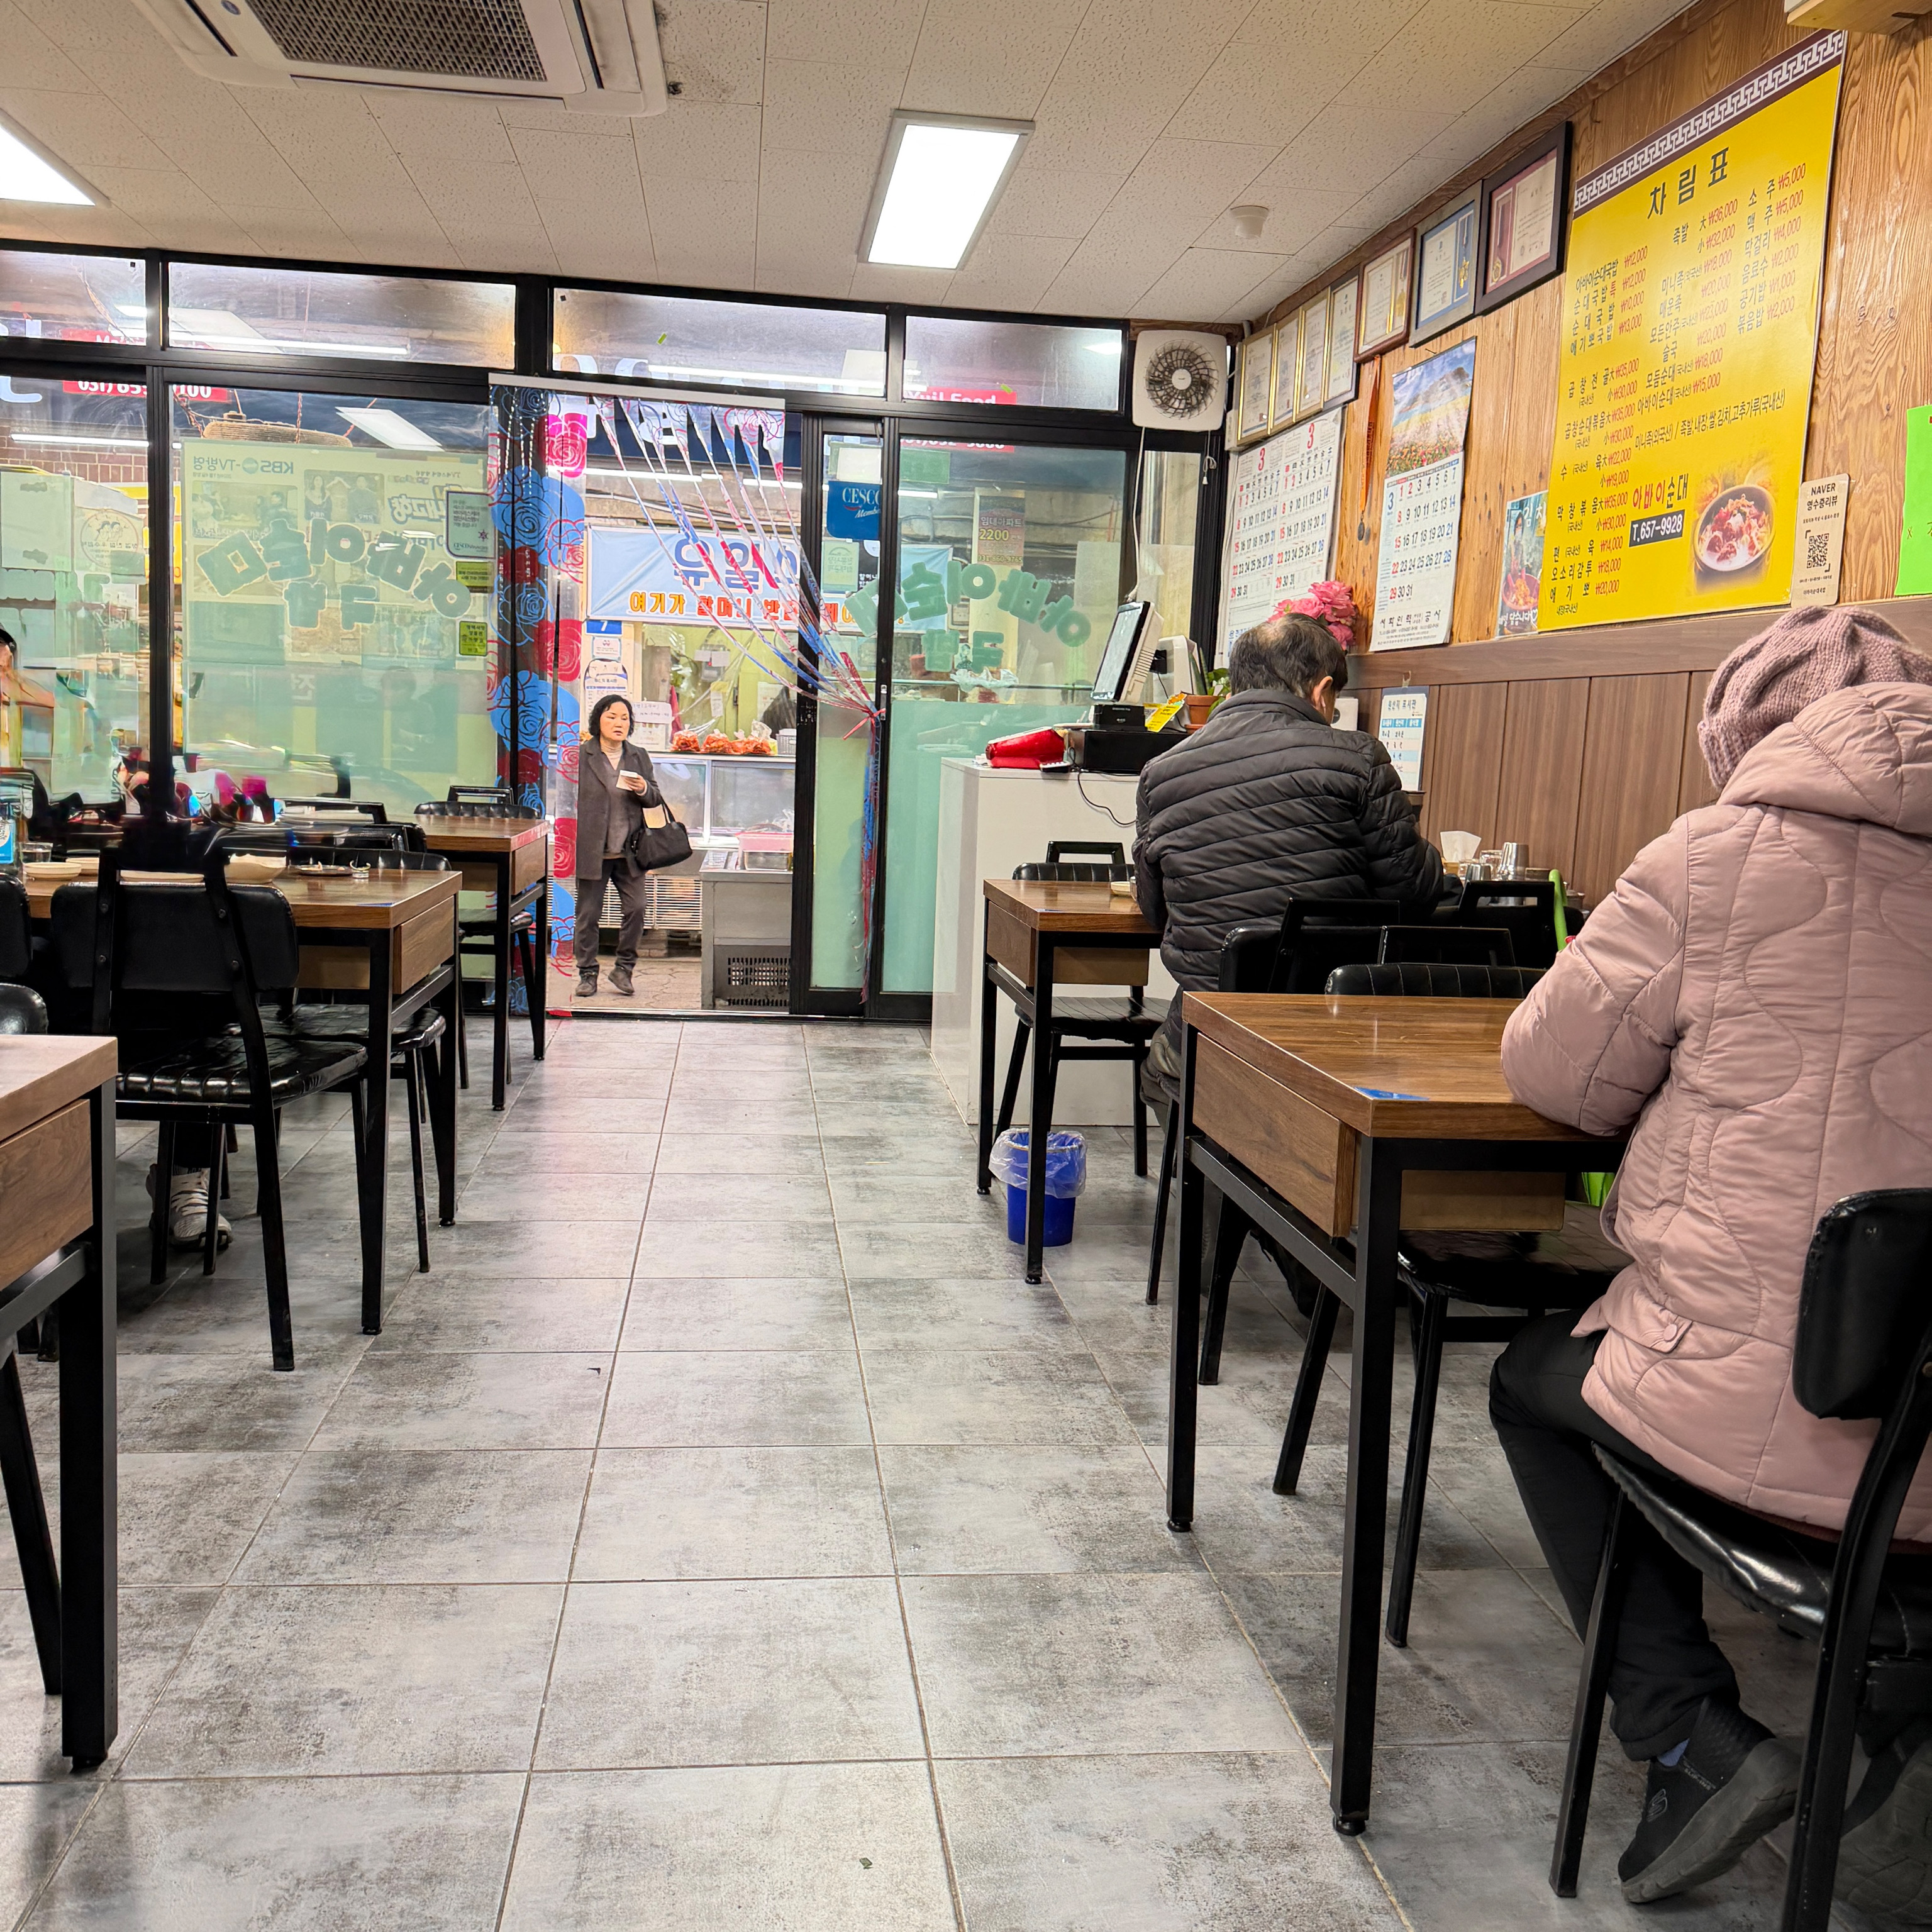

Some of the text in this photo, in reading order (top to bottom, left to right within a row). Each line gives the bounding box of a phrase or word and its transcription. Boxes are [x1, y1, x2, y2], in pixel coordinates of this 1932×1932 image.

[1647, 147, 1729, 219] 차림표
[1673, 222, 1689, 245] 족발
[1745, 229, 1771, 258] 막걸리
[1575, 258, 1619, 293] 아바이순대국밥
[1742, 256, 1768, 285] 음료수
[1740, 280, 1766, 309] 공기밥
[1307, 423, 1315, 449] 3
[1258, 447, 1265, 472] 3
[1400, 467, 1456, 497] 1 2 3 4 5 6 7
[1633, 473, 1689, 509] 아바이순대
[1811, 482, 1836, 496] NAVER
[855, 509, 880, 518] Membe
[1388, 492, 1394, 510] 3
[1397, 494, 1455, 523] 8 9 10 11 12 13 14
[1807, 495, 1838, 511] 영수증리뷰
[979, 529, 1009, 541] 2200
[1395, 522, 1453, 548] 15 16 17 18 19 20 21
[1633, 514, 1682, 542] T.657-9928
[1392, 550, 1451, 574] 22 23 24 25 26 27 28
[630, 591, 686, 614] 여기가
[1390, 584, 1413, 599] 29 30 31
